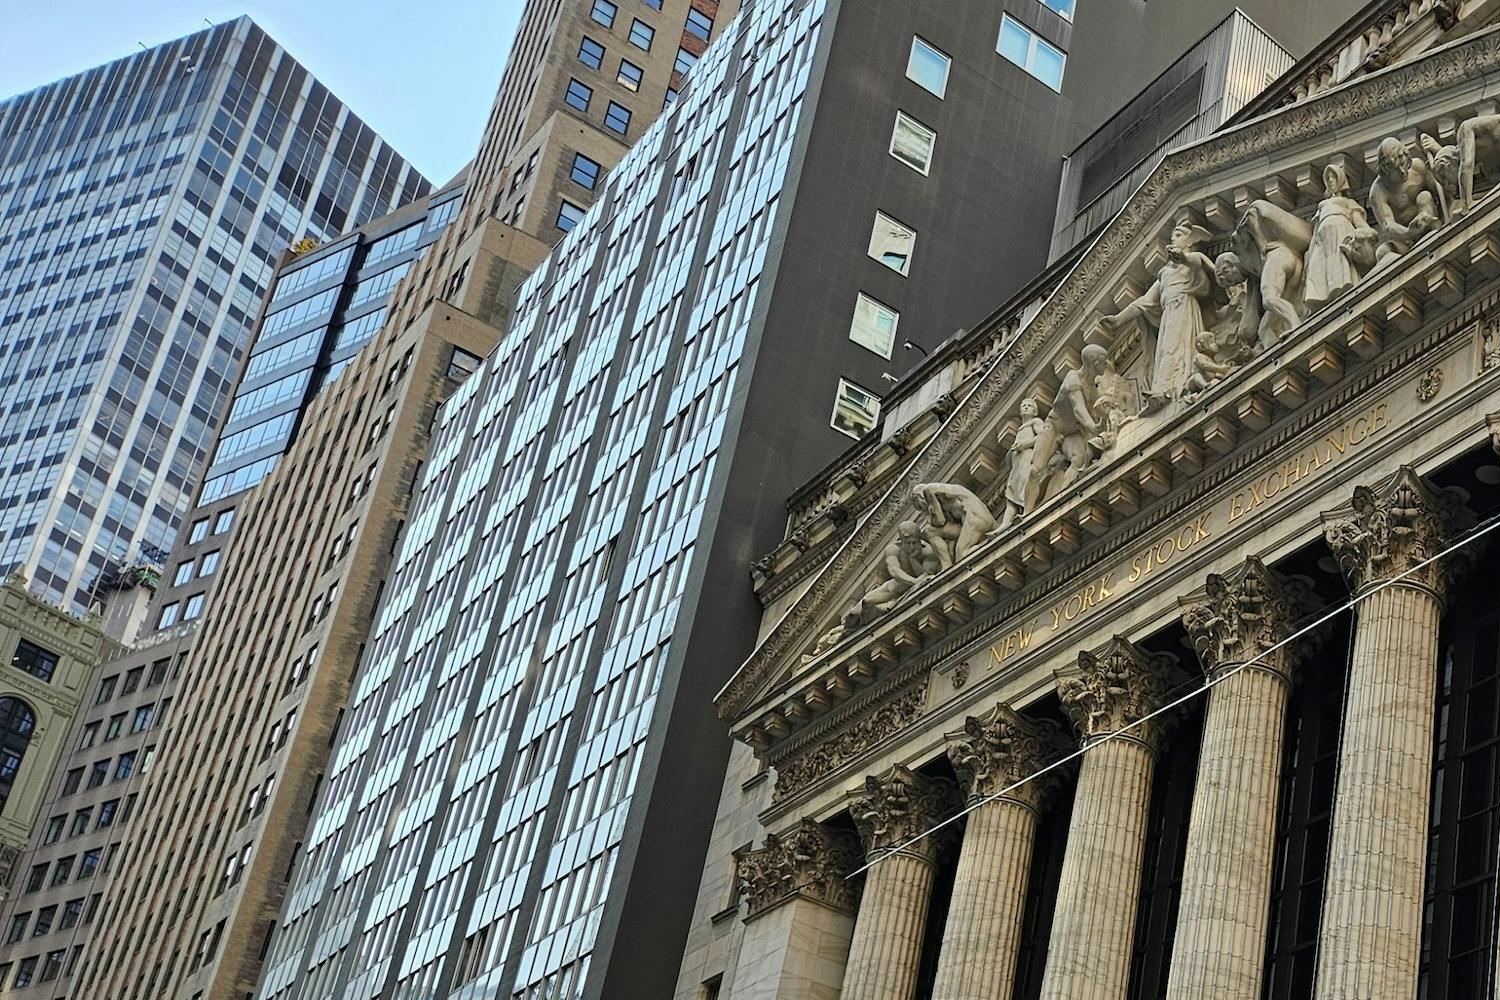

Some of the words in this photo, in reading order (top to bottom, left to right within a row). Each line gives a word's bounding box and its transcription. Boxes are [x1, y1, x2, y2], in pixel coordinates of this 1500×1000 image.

[987, 620, 1038, 670] NEW
[1050, 572, 1114, 631] YORK
[1129, 511, 1212, 583] STOCK
[1228, 403, 1388, 523] EXCHANGE
